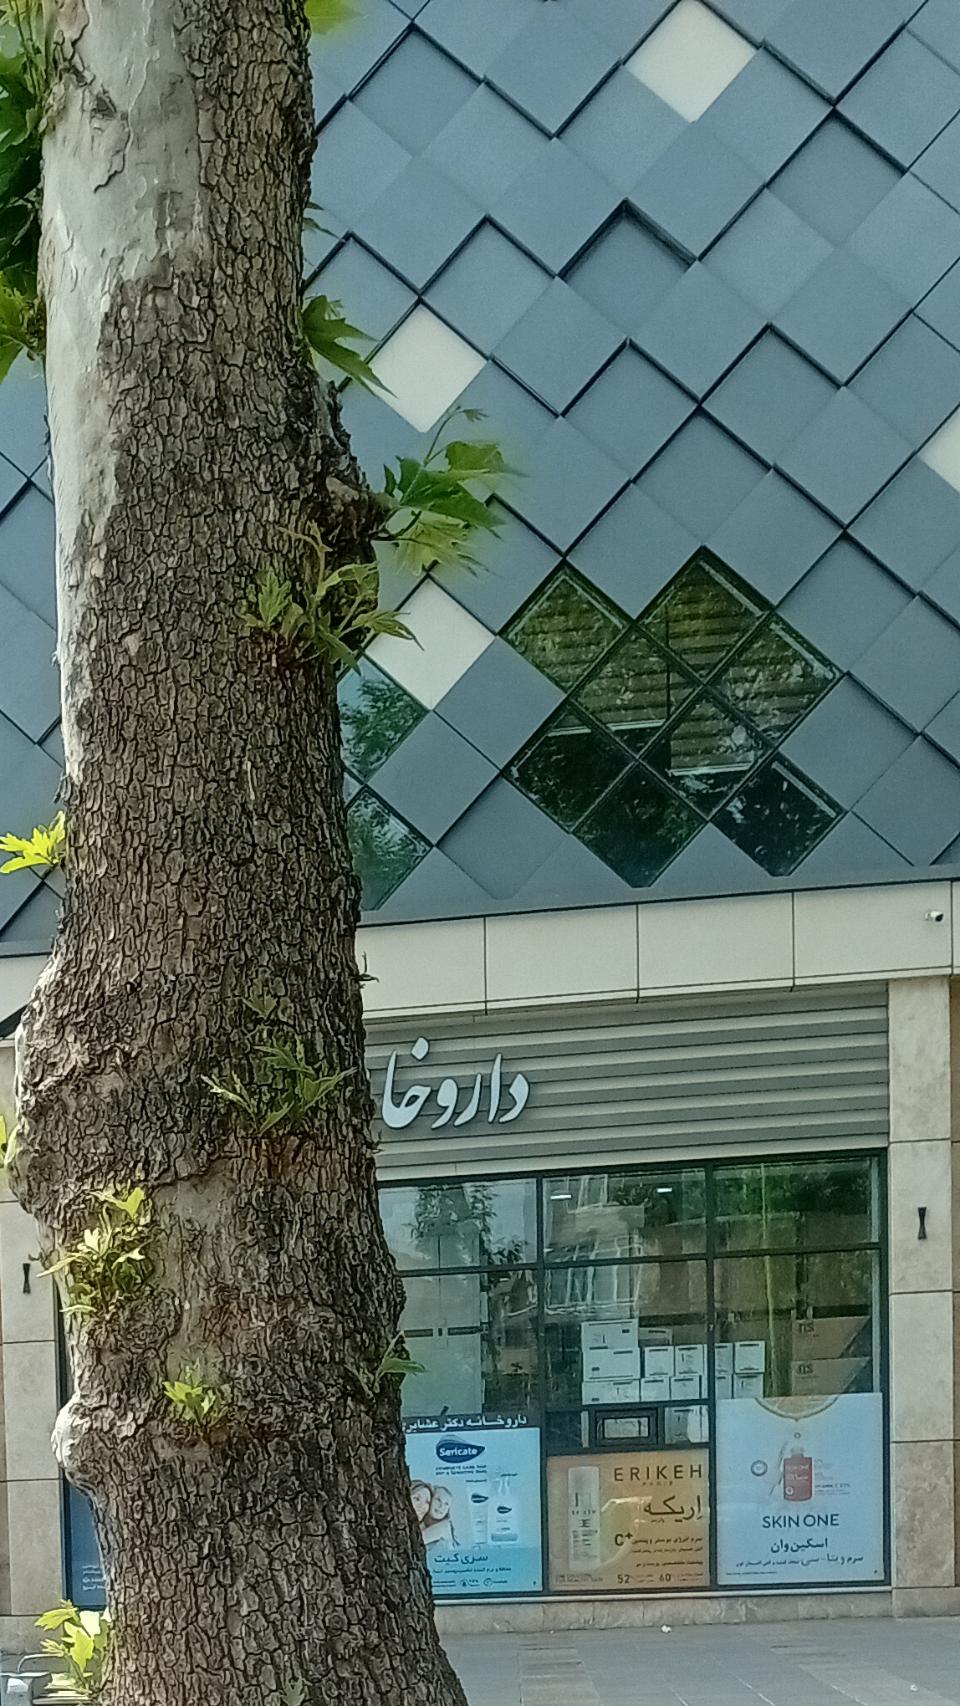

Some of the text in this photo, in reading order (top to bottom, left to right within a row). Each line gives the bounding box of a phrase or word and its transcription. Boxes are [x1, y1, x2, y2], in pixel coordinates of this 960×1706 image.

[382, 1037, 529, 1130] داروخا
[440, 1417, 464, 1431] دکتر
[466, 1413, 527, 1428] داروخانه
[613, 1464, 702, 1482] ERIKEH
[761, 1513, 840, 1529] SKIN ONE
[770, 1537, 828, 1553] اسکین وان
